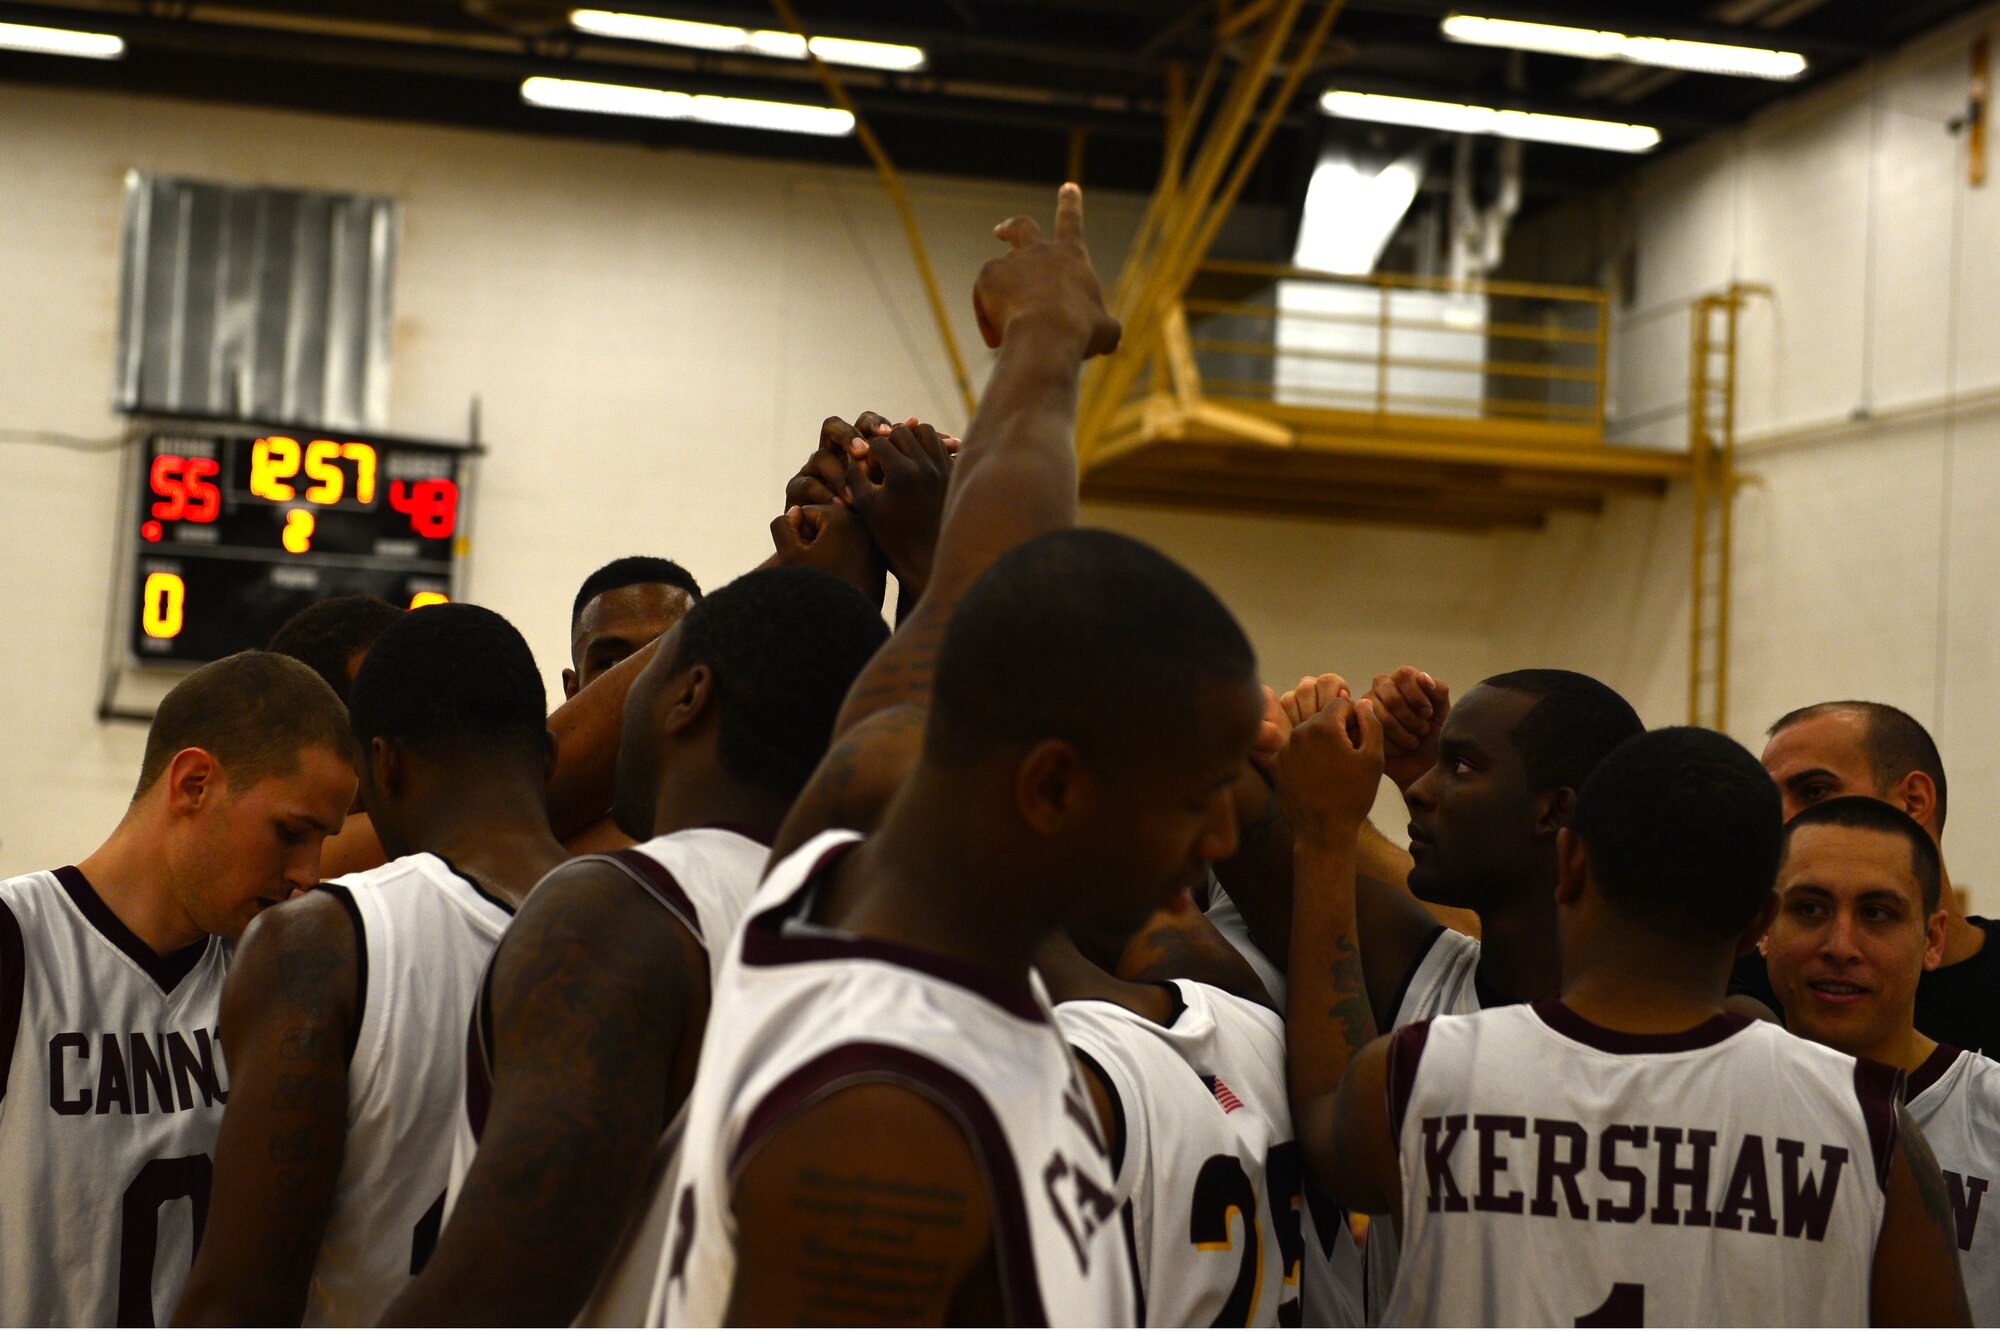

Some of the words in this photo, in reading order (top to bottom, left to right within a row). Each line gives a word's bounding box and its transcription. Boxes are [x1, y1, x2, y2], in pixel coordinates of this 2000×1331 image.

[151, 455, 221, 523] 55
[388, 478, 458, 539] 48
[142, 572, 185, 639] 0
[1422, 1114, 1848, 1242] KERSHAW
